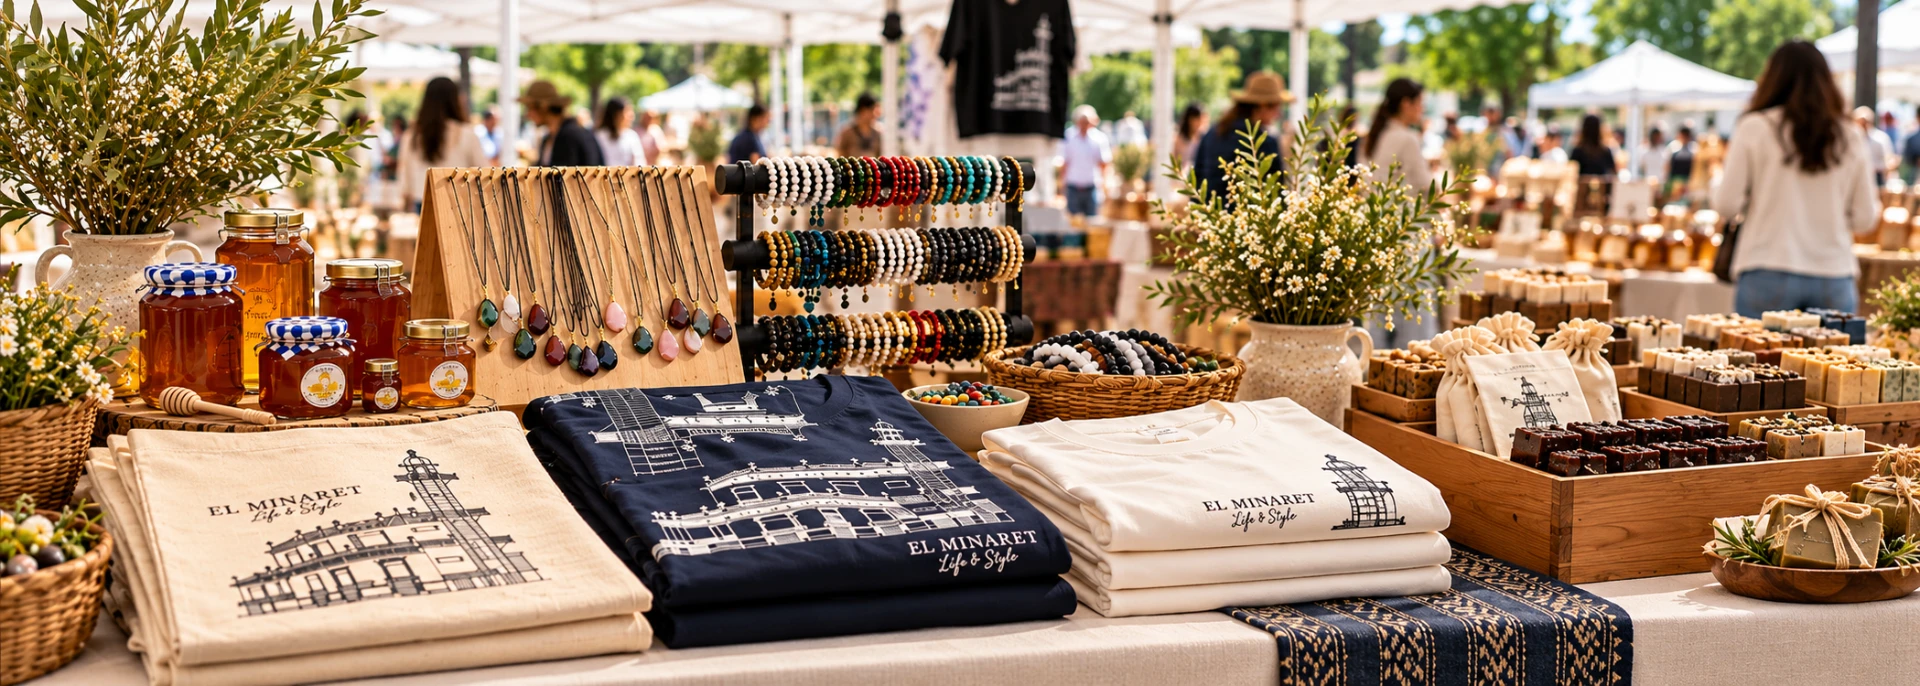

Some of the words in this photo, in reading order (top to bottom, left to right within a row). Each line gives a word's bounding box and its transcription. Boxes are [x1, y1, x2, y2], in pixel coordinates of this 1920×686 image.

[208, 505, 240, 516] EL
[246, 485, 362, 512] MINARET
[251, 508, 281, 523] Life
[285, 507, 296, 516] &
[299, 498, 342, 516] Style
[1202, 500, 1228, 512] EL
[1230, 493, 1315, 510] MINARET
[1231, 510, 1255, 532] Life
[1258, 511, 1266, 523] &
[1267, 507, 1298, 529] Style
[907, 540, 936, 556] EL
[938, 530, 1038, 552] MINARET
[938, 552, 968, 577] Life
[970, 552, 981, 566] &
[983, 546, 1019, 573] Style
